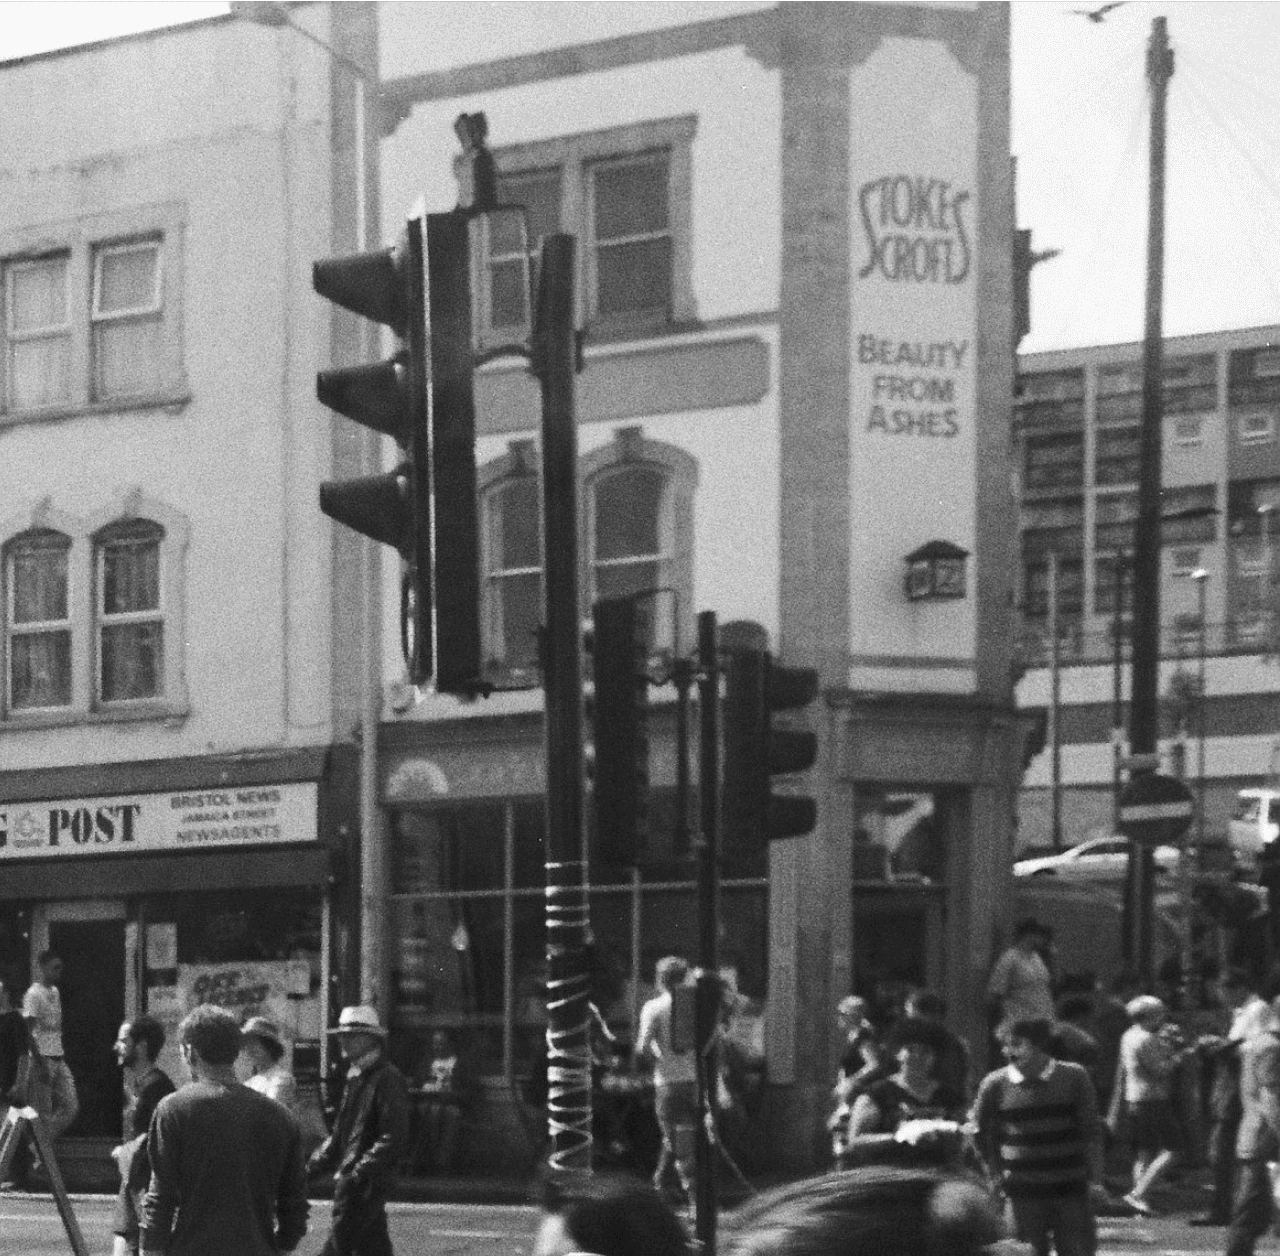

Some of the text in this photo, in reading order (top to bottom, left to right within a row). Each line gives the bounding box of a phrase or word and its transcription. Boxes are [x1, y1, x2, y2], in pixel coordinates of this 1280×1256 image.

[857, 333, 968, 368] BEAUTY
[872, 374, 954, 401] FROM
[865, 404, 960, 438] ASHES
[171, 789, 281, 809] BRISTOL NEWS
[49, 804, 141, 846] POST
